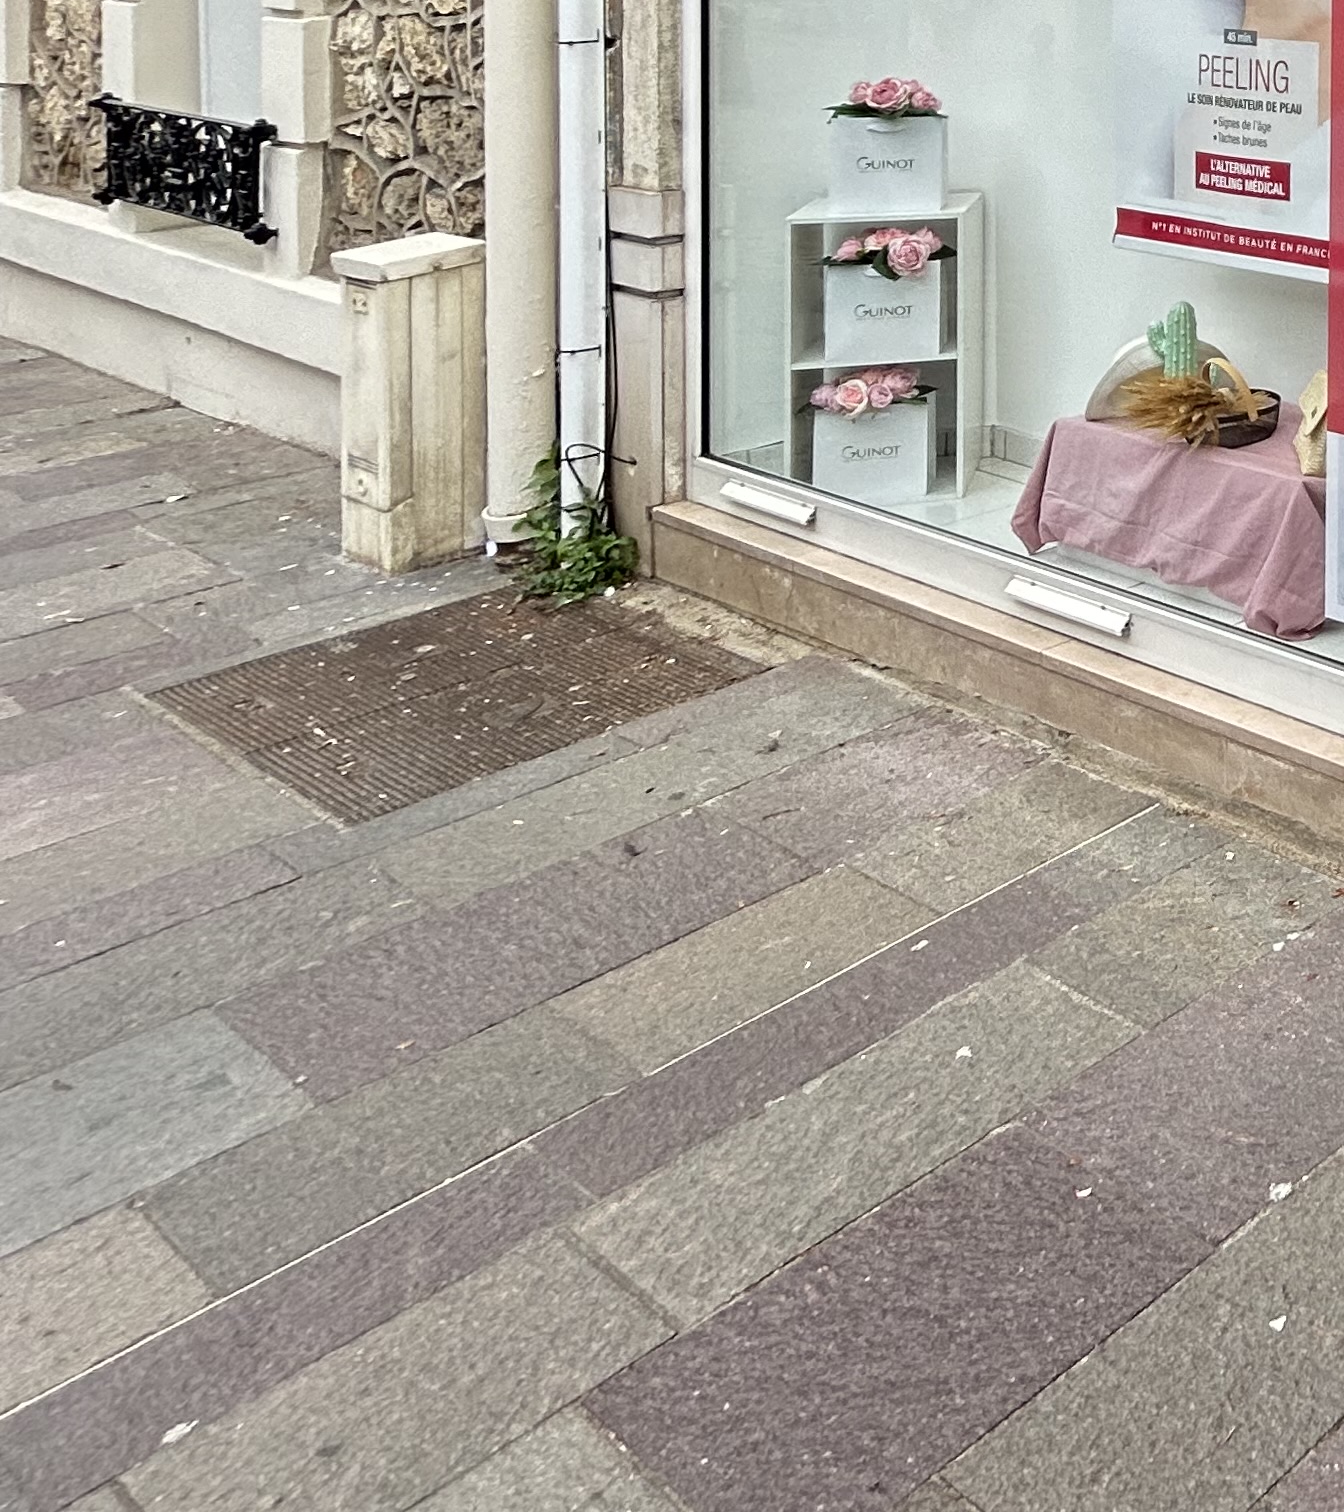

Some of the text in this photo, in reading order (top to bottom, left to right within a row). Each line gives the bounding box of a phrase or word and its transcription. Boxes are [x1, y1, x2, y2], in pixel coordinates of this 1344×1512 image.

[1198, 53, 1290, 95] PEELING
[1187, 91, 1197, 104] LE
[1265, 100, 1278, 114] DE
[1279, 102, 1303, 115] PEAU
[855, 155, 916, 172] GUINOT
[1223, 232, 1236, 244] DE
[1280, 241, 1293, 253] EN
[853, 303, 914, 320] GUINOT
[841, 444, 902, 460] GUINOT
